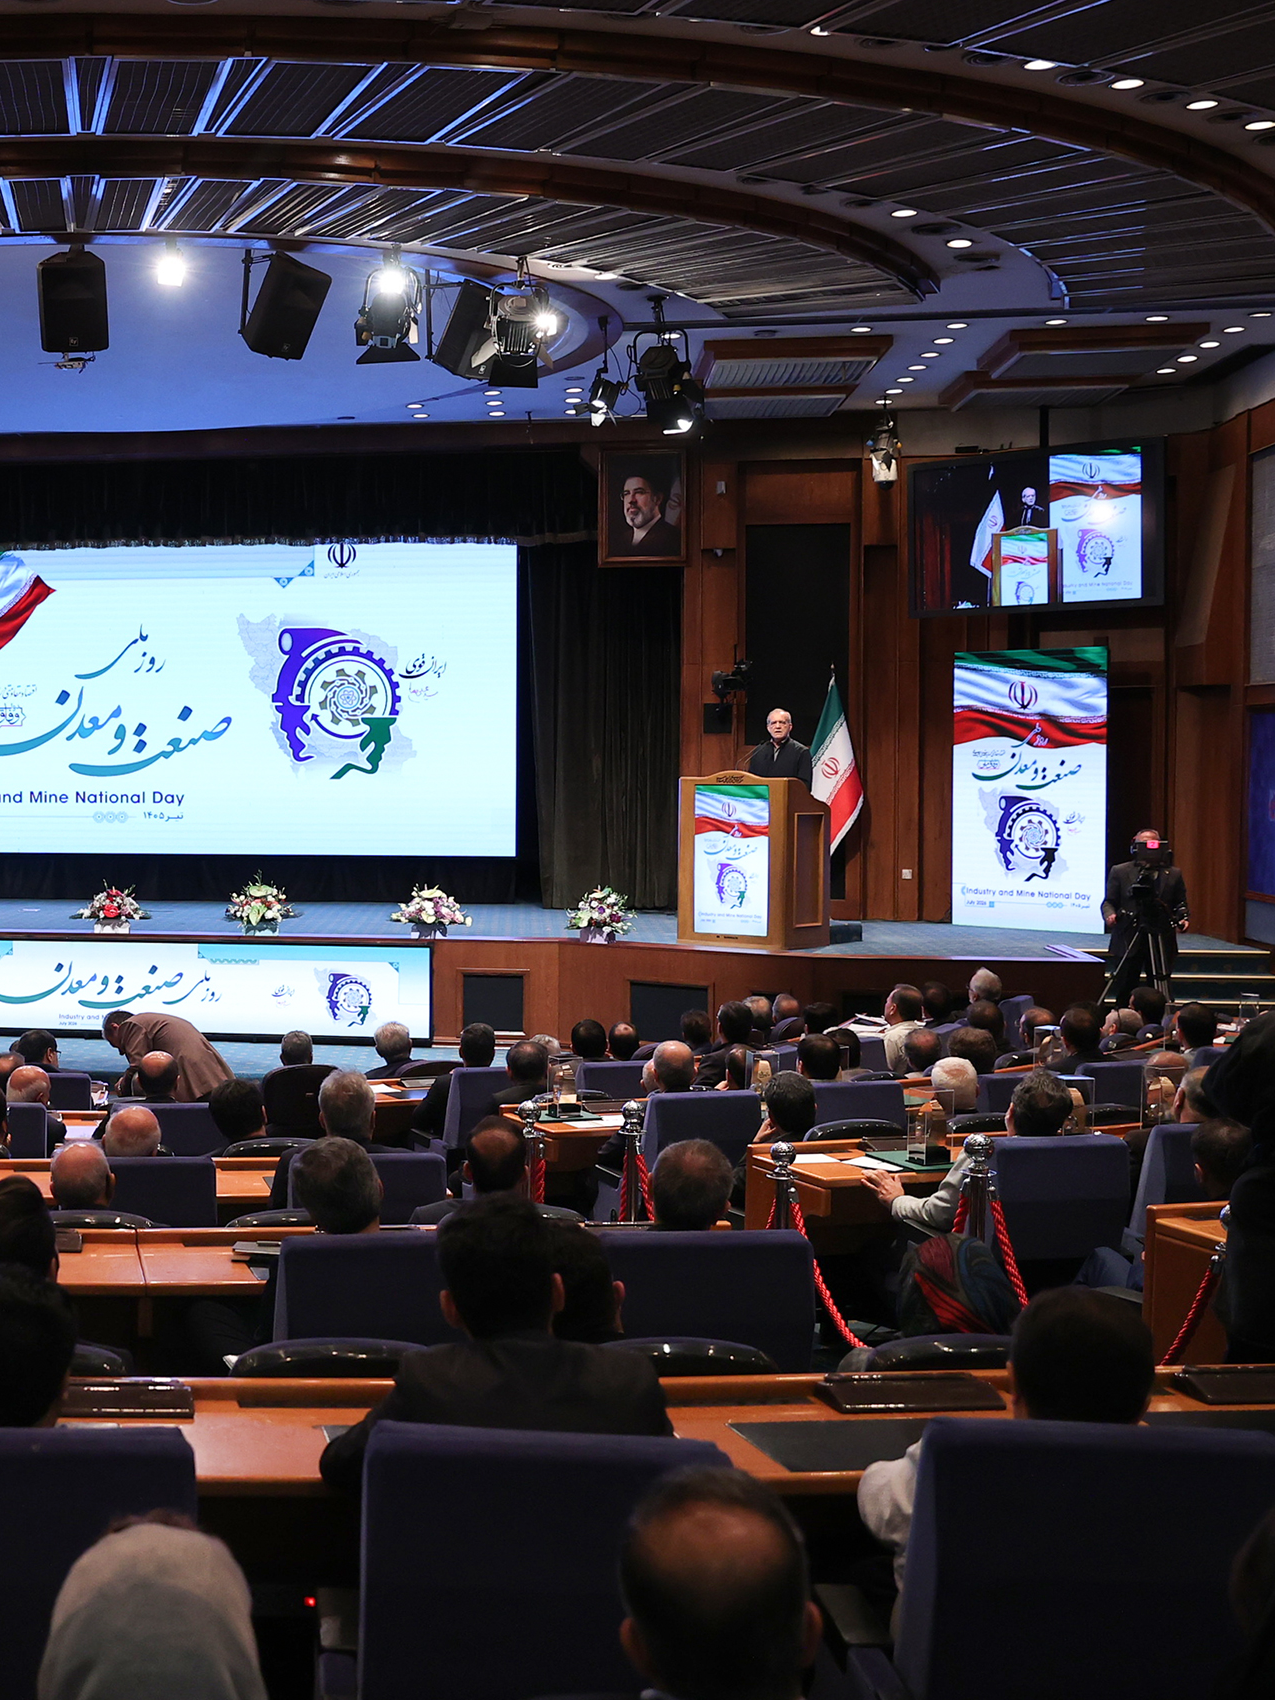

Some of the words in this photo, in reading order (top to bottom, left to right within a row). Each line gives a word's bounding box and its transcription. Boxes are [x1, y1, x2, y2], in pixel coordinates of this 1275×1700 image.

[74, 623, 149, 679] ملی
[134, 651, 166, 673] روز
[68, 706, 232, 777] صنعت
[108, 724, 126, 755] و
[971, 751, 1037, 781] معدن
[1015, 759, 1082, 791] صنعت
[1031, 767, 1039, 781] و
[29, 791, 69, 804] Mine
[75, 791, 146, 804] National
[152, 791, 185, 806] Day
[966, 887, 996, 896] Industry
[998, 889, 1014, 897] and
[1016, 890, 1035, 898] Mine
[1038, 891, 1072, 899] National
[1075, 892, 1091, 901] Day
[77, 964, 184, 1010] صنعت
[97, 975, 110, 996] و
[162, 969, 211, 1005] ملی
[200, 988, 223, 1003] روز
